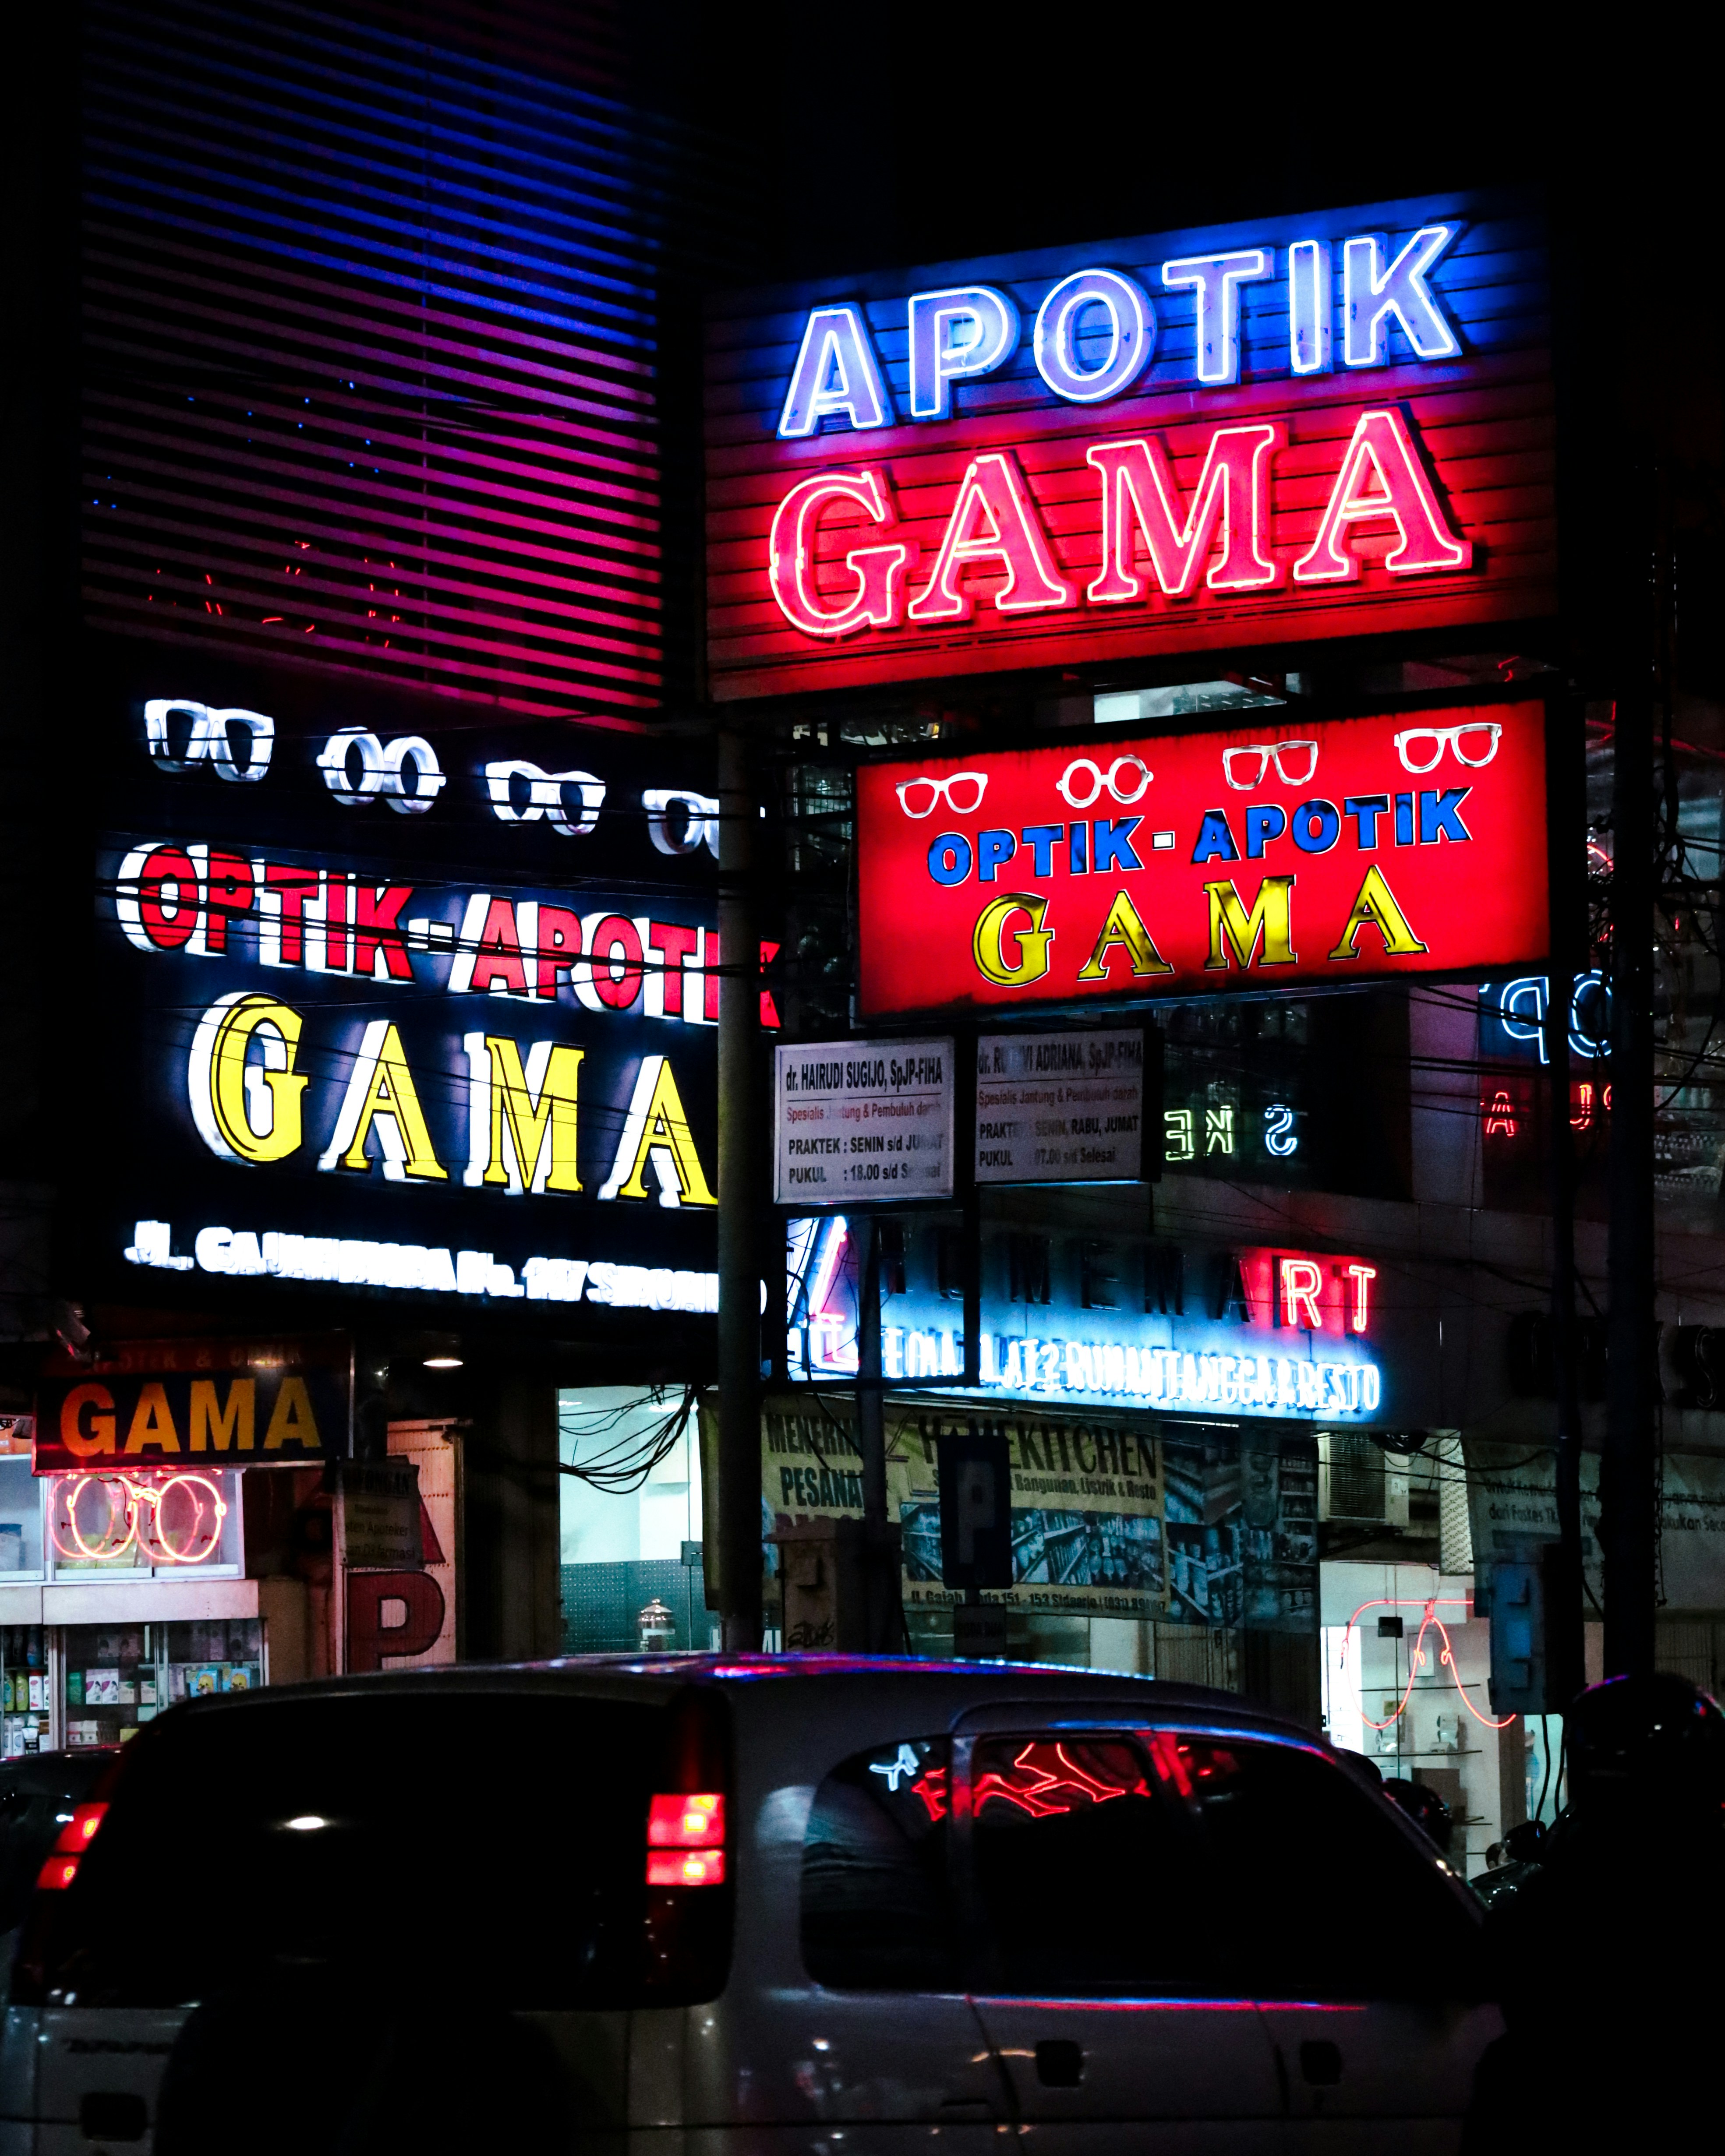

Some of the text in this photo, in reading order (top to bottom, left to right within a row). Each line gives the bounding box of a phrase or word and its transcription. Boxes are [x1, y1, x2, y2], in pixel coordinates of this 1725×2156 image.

[776, 222, 1464, 439] APOTIK
[768, 402, 1474, 639] GAMA
[972, 864, 1429, 988] GAMA
[787, 1057, 942, 1092] dr. HAIRUDI SUGIJO, SpJP-FIHA
[189, 991, 719, 1210] GAMA
[787, 1107, 824, 1124] Spesialis
[863, 1104, 869, 1117] &
[872, 1102, 914, 1117] Pembuluh
[1071, 1118, 1101, 1136] RABU,
[1105, 1115, 1138, 1133] JUMAT
[789, 1138, 840, 1154] PRAKTEK
[850, 1136, 884, 1153] SENIN
[887, 1136, 902, 1151] s/d
[980, 1150, 1013, 1167] PUKUL
[1080, 1147, 1116, 1163] Selesai
[789, 1167, 827, 1183] PUKUL
[851, 1164, 879, 1181] 18.00
[883, 1163, 898, 1179] s/d
[60, 1377, 322, 1457] GAMA
[1126, 1481, 1156, 1500] Resto
[1029, 1593, 1050, 1607] 153
